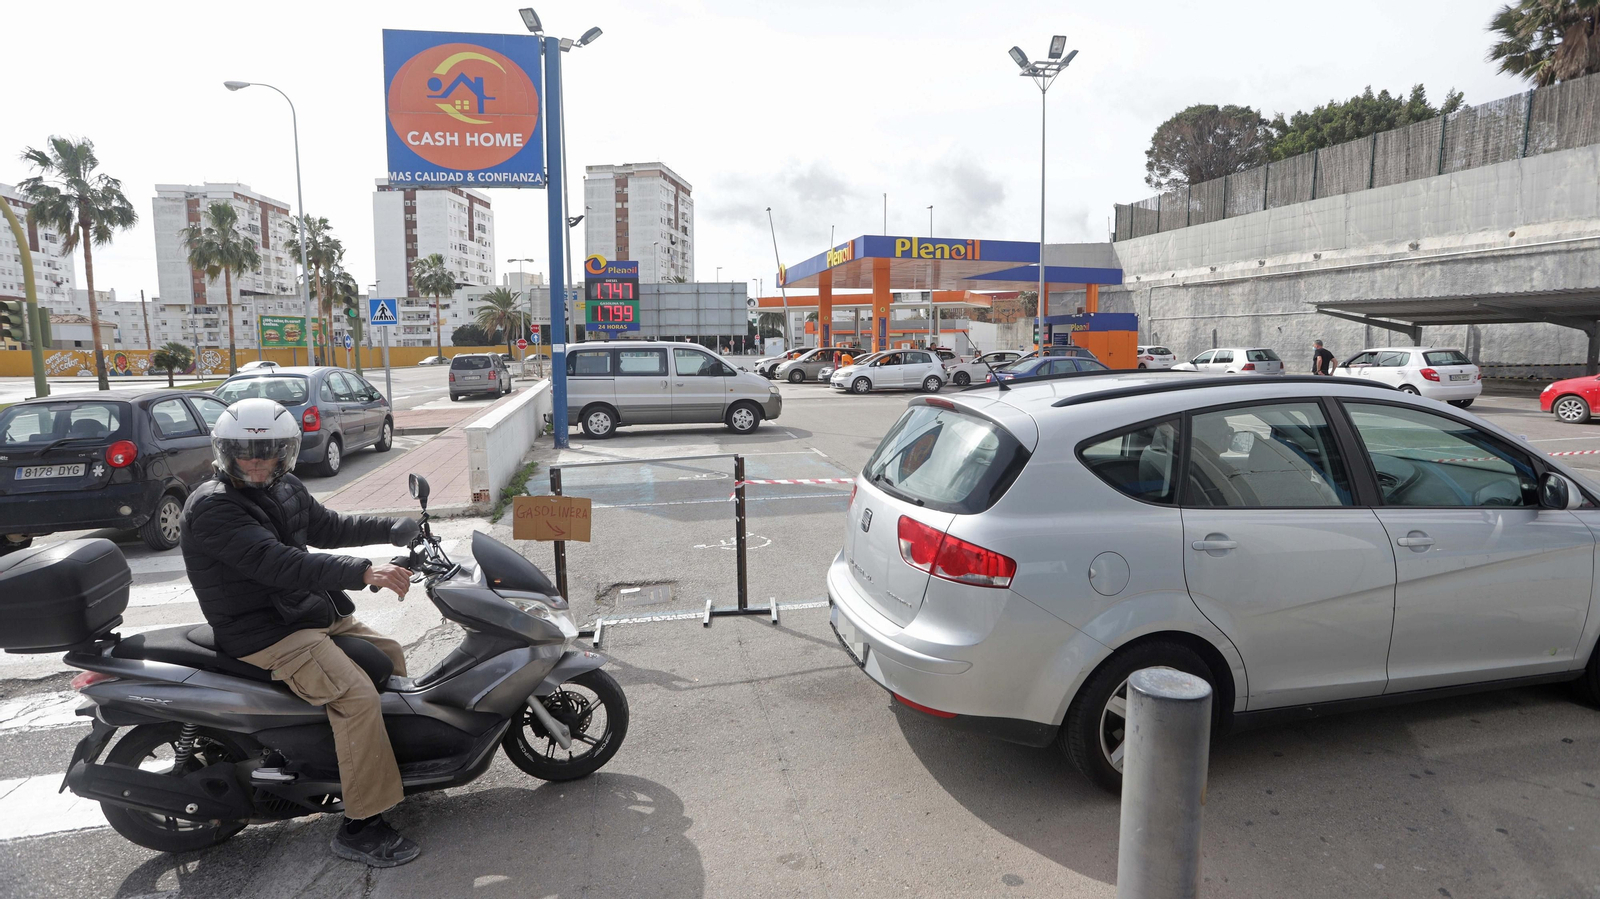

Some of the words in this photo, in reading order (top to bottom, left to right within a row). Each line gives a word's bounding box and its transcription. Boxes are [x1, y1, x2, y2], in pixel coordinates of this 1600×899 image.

[406, 131, 459, 146] CASH
[466, 132, 523, 147] HOME
[388, 172, 412, 182] MAS
[414, 172, 464, 182] CALIDAD
[466, 172, 475, 182] &
[478, 173, 542, 182] CONFIANZA
[827, 239, 855, 268] Plenoil
[895, 236, 980, 260] Plenoil
[597, 283, 633, 299] 1.747
[597, 305, 633, 322] 1.799
[1071, 322, 1090, 331] Plenoil
[59, 357, 79, 371] color
[24, 467, 53, 477] 8178
[58, 466, 80, 476] DYG
[516, 504, 588, 519] GASOLINERA
